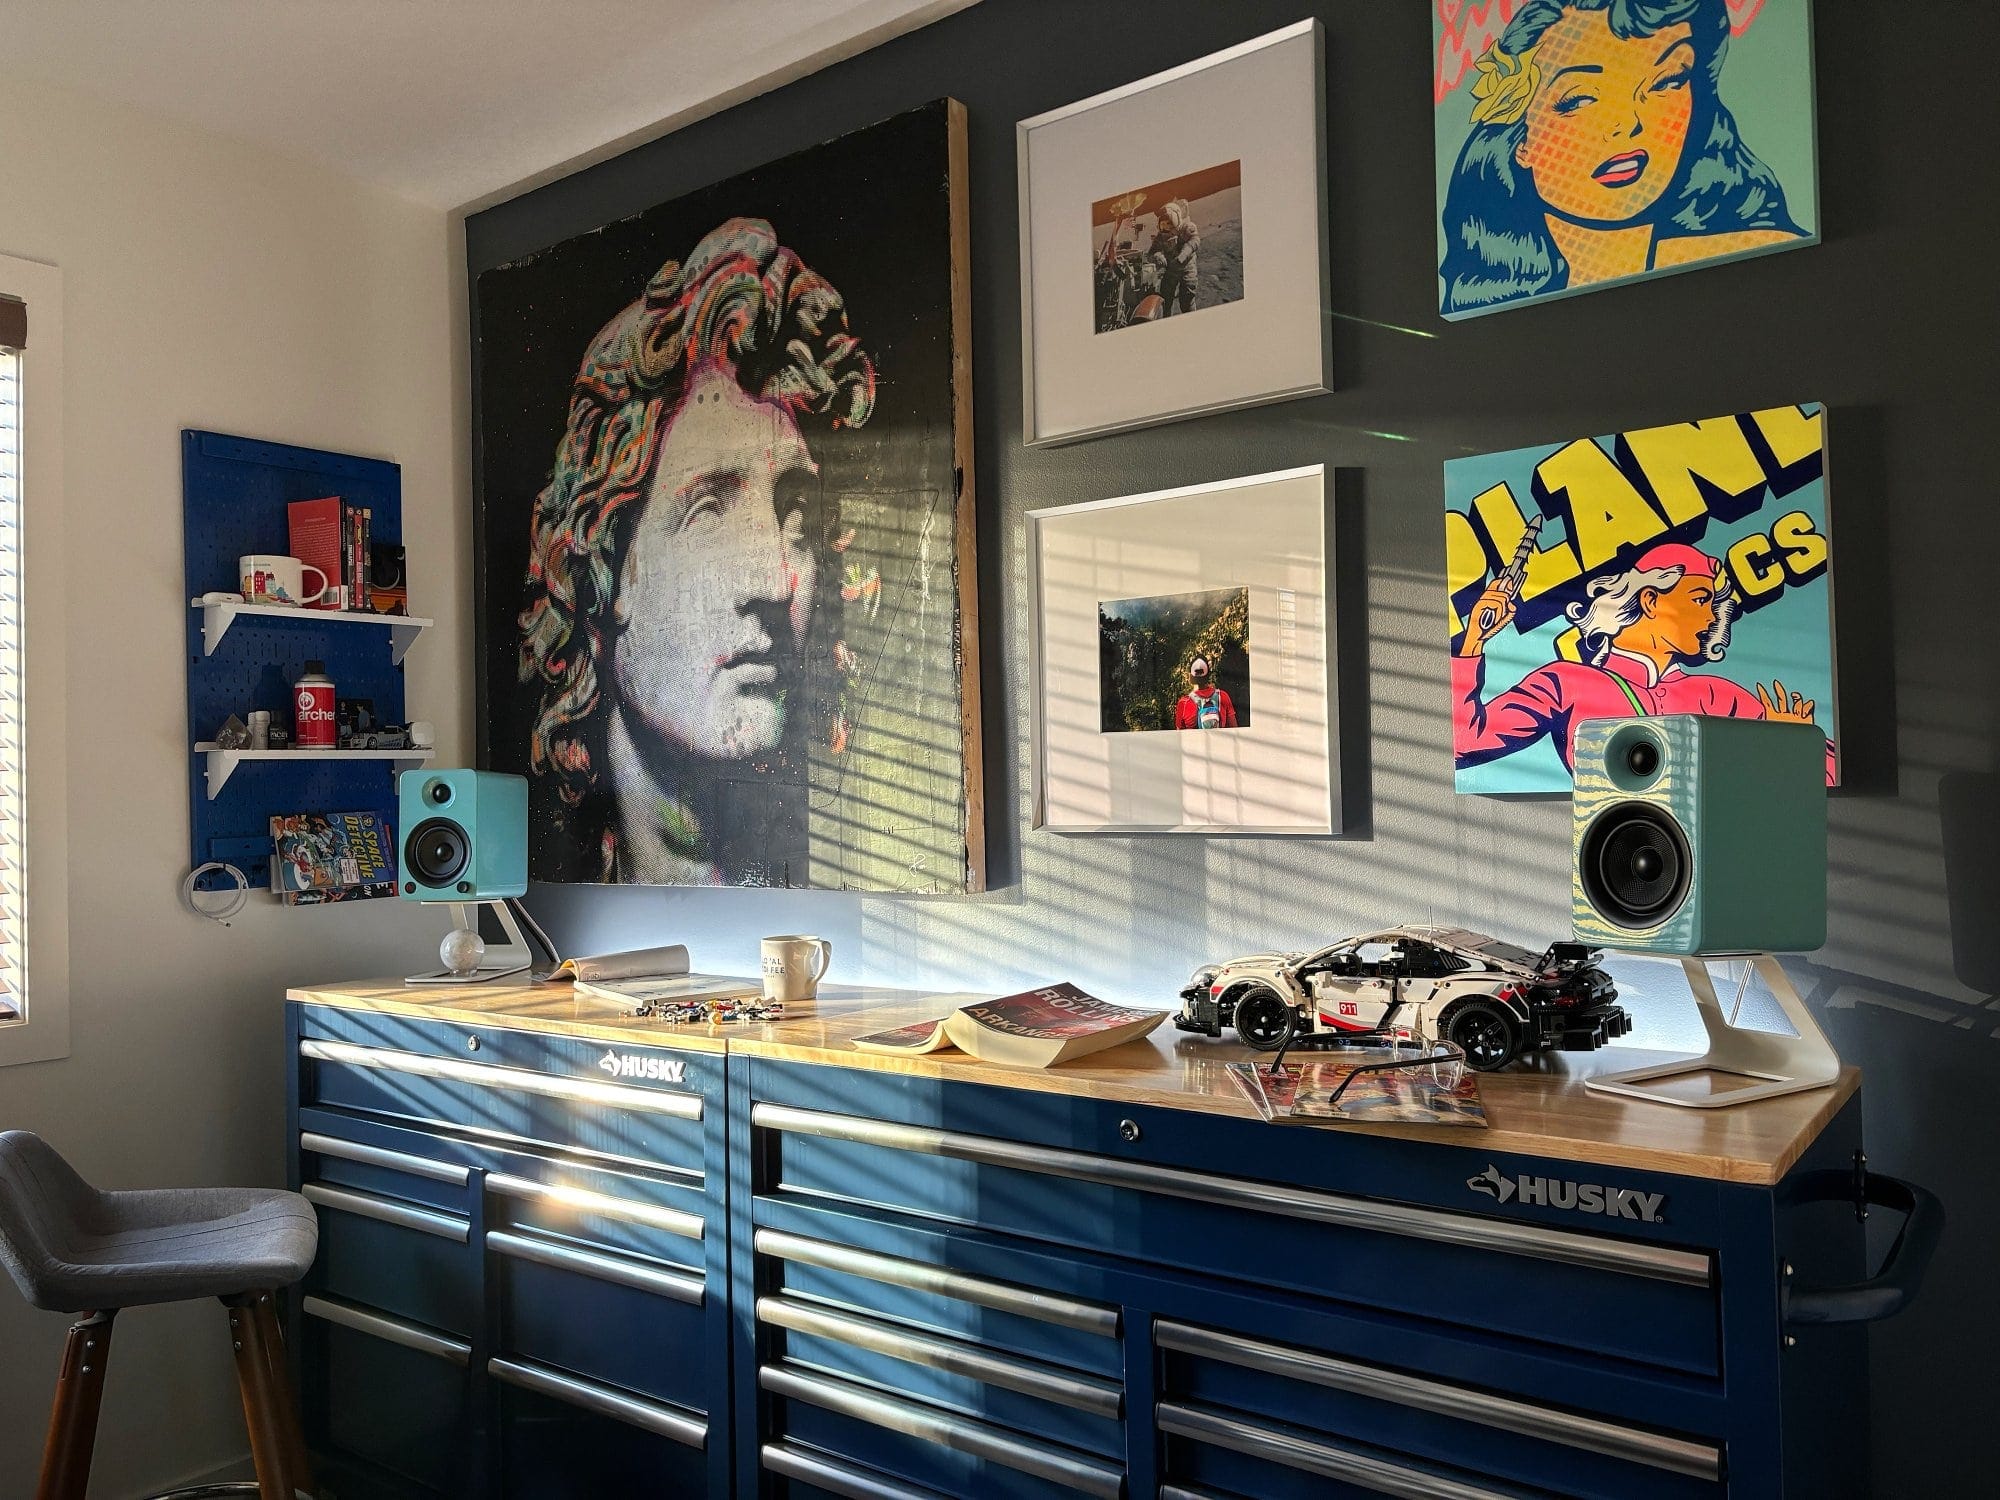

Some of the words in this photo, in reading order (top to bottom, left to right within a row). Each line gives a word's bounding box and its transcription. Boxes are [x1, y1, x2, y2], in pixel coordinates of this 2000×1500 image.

[1716, 511, 1827, 603] CS
[343, 815, 375, 879] DETECTIVE
[362, 829, 388, 869] SPACE
[1340, 1003, 1357, 1015] 911
[621, 1054, 684, 1083] HUSKY
[1518, 1174, 1665, 1222] HUSKY
